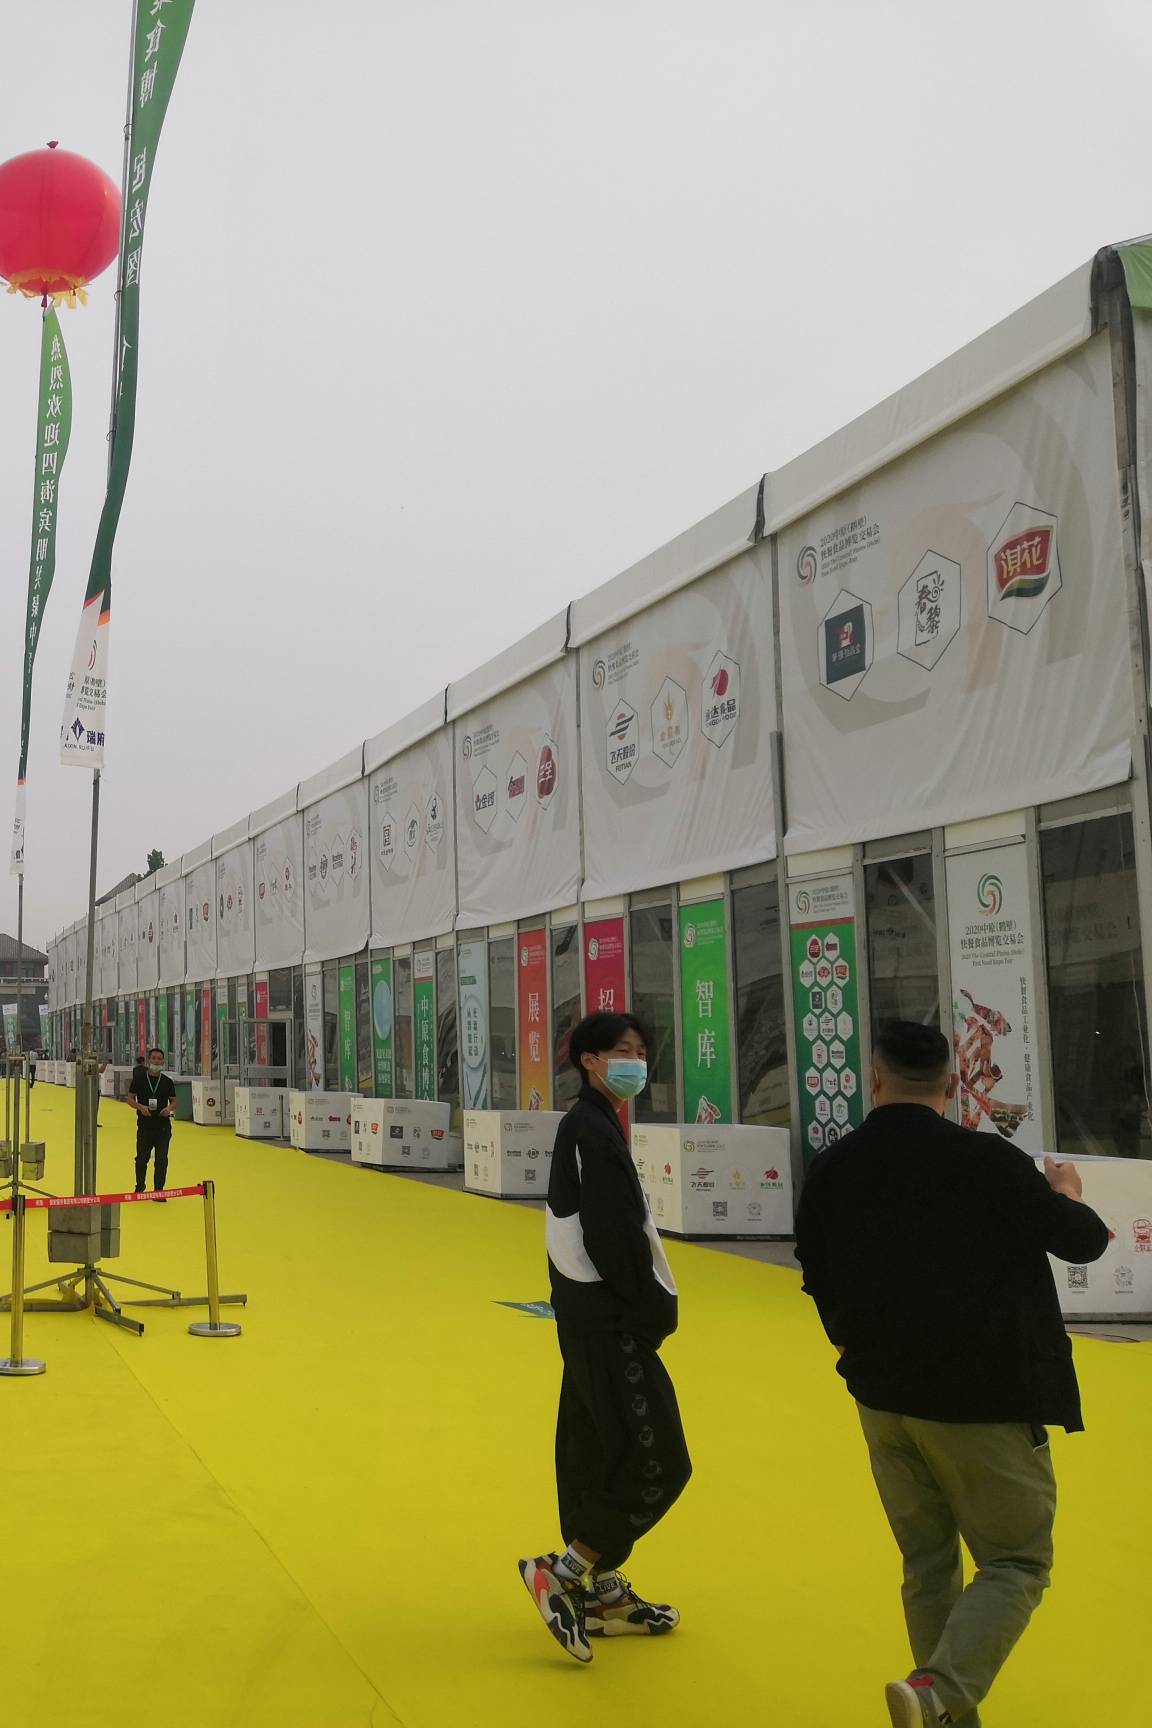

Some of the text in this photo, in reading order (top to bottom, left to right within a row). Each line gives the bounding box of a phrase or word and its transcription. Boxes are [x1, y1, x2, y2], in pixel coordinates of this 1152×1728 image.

[1001, 537, 1043, 579] 淇花
[527, 992, 541, 1063] 展览
[695, 980, 716, 1069] 智库
